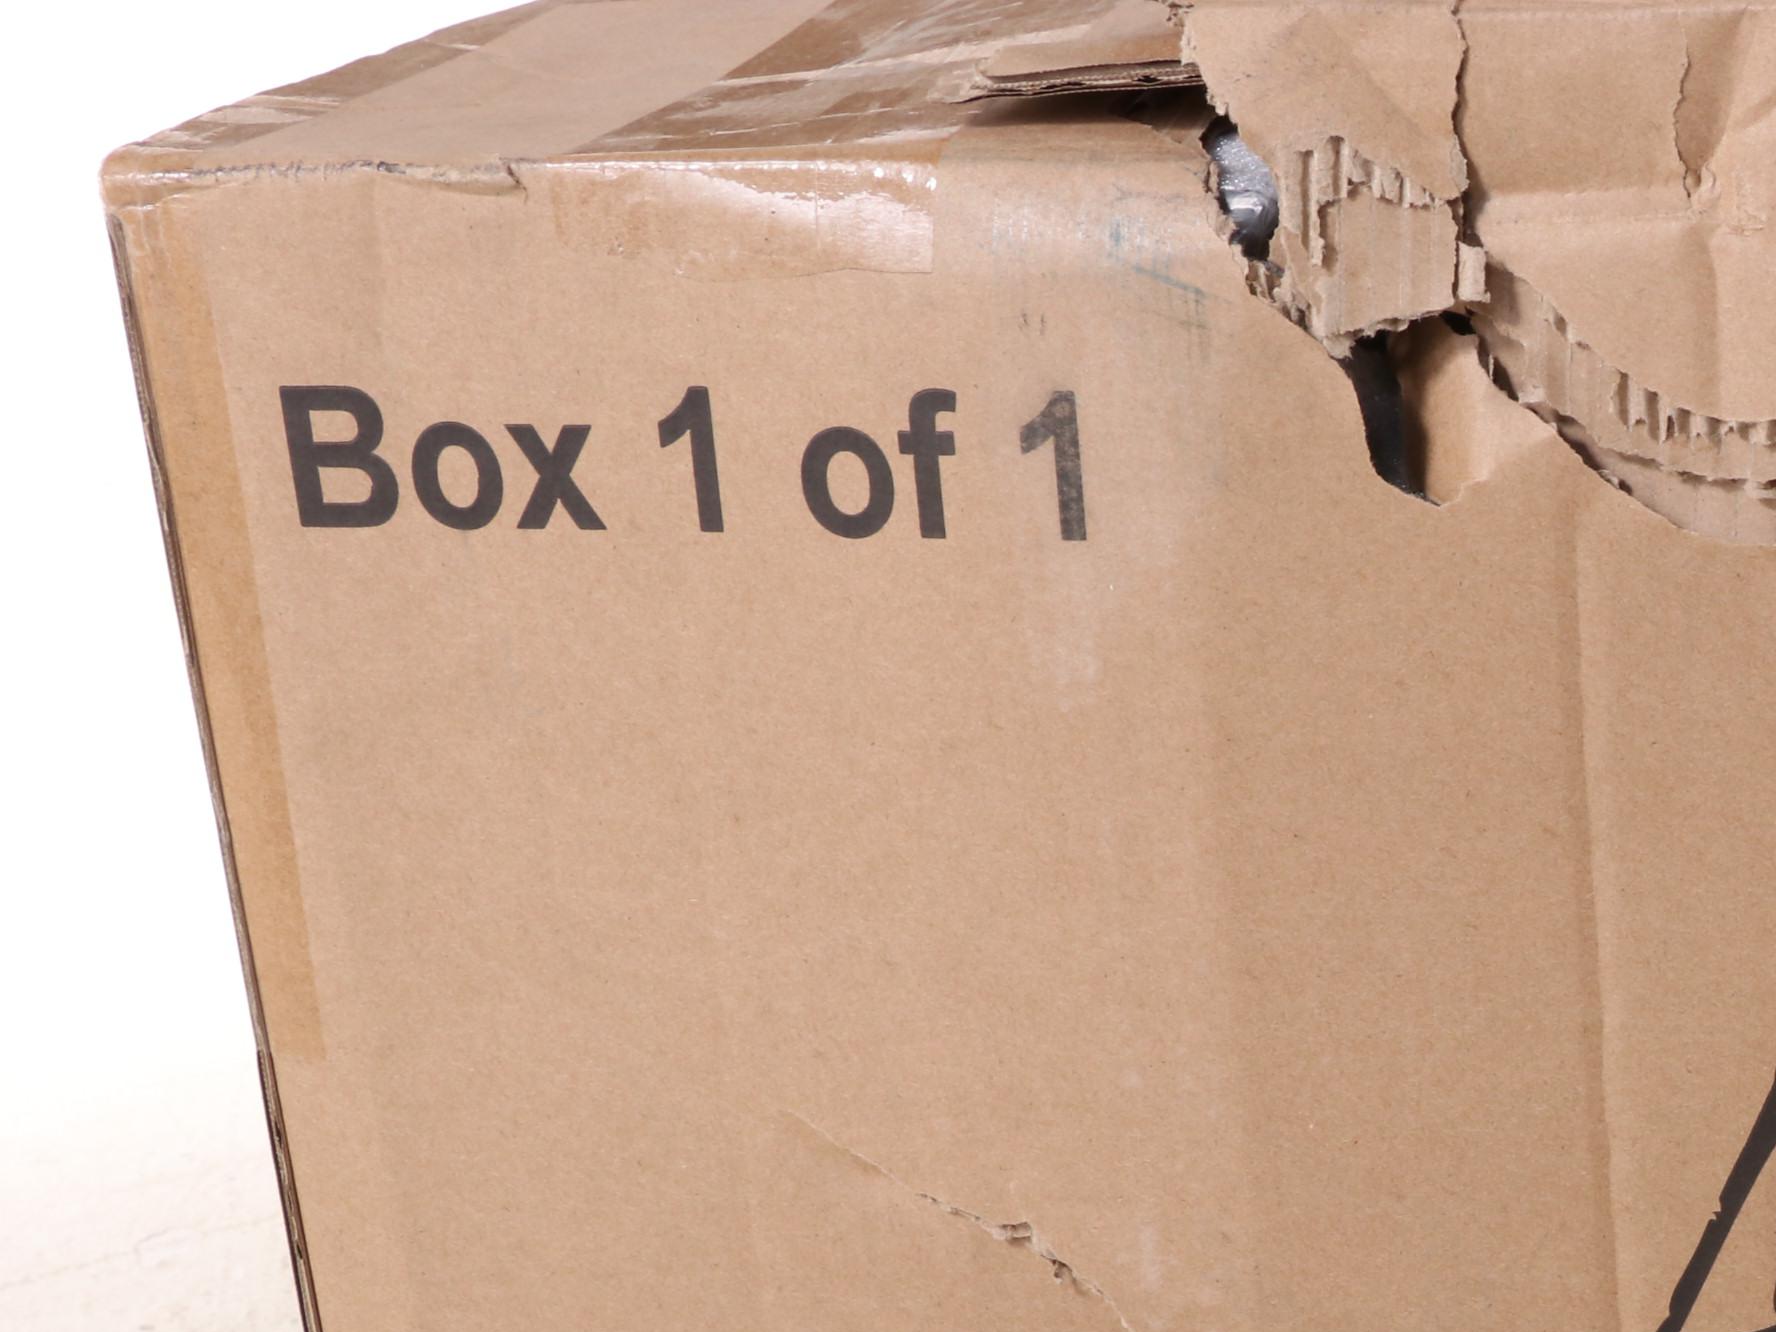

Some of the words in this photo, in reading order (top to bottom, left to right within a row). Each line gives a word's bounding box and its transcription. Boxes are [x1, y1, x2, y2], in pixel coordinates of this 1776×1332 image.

[279, 385, 608, 531] Box
[657, 385, 724, 533] 1
[801, 388, 957, 539] of
[1020, 390, 1087, 541] 1
